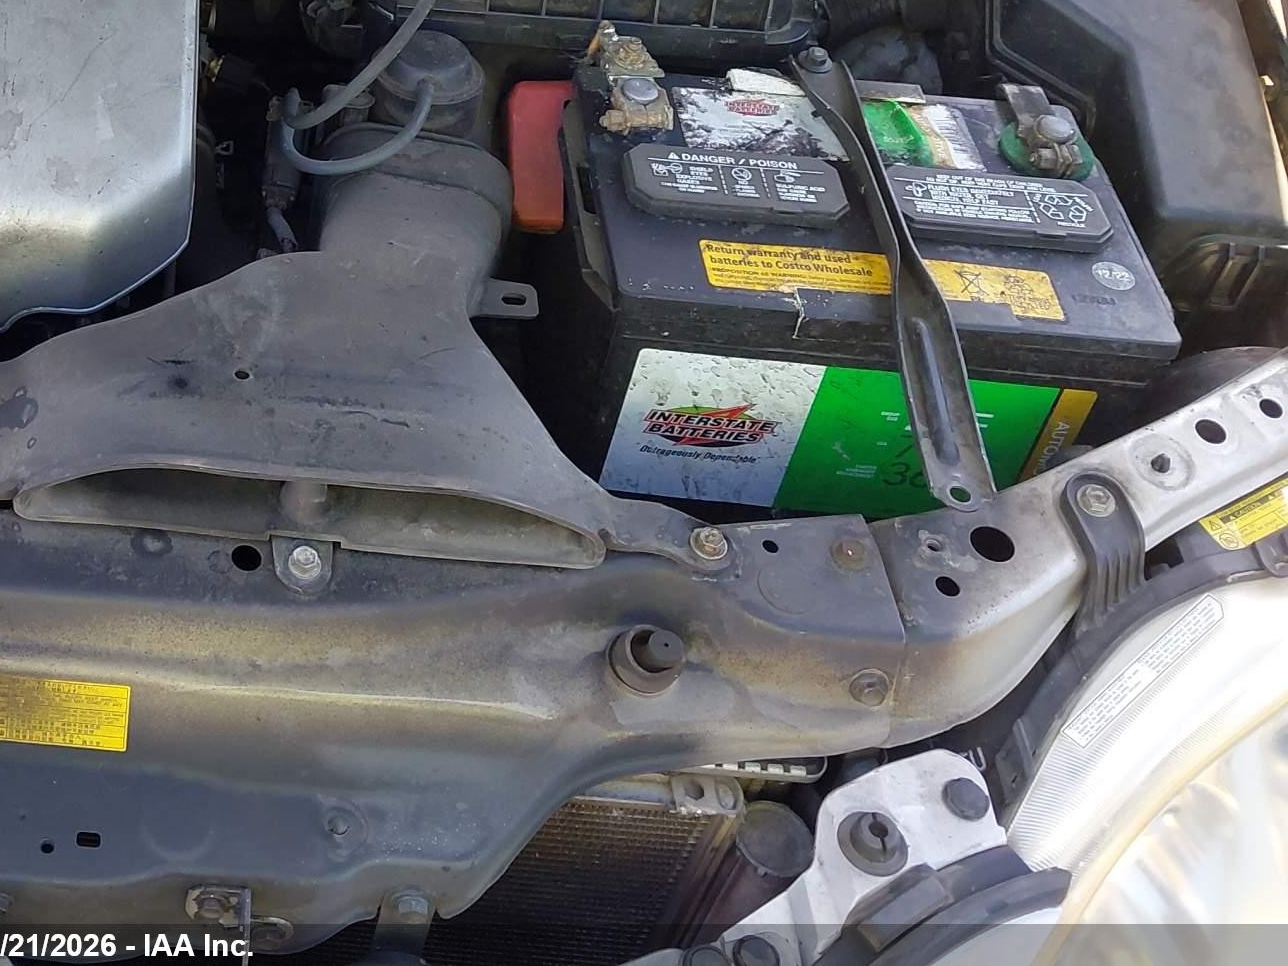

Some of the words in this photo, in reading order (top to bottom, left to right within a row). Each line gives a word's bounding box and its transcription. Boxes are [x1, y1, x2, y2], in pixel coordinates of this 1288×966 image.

[682, 153, 735, 165] DANGER
[749, 159, 798, 170] POISON
[706, 244, 745, 255] Return
[747, 248, 797, 261] warranty
[797, 251, 821, 261] and
[824, 253, 852, 264] used
[709, 256, 759, 268] batteries
[761, 259, 772, 269] to
[775, 260, 812, 272] Costco
[813, 263, 873, 277] Wholesale
[1096, 267, 1130, 282] 12/22
[648, 410, 776, 432] INTERSTATE
[648, 423, 760, 443] BATTERIES
